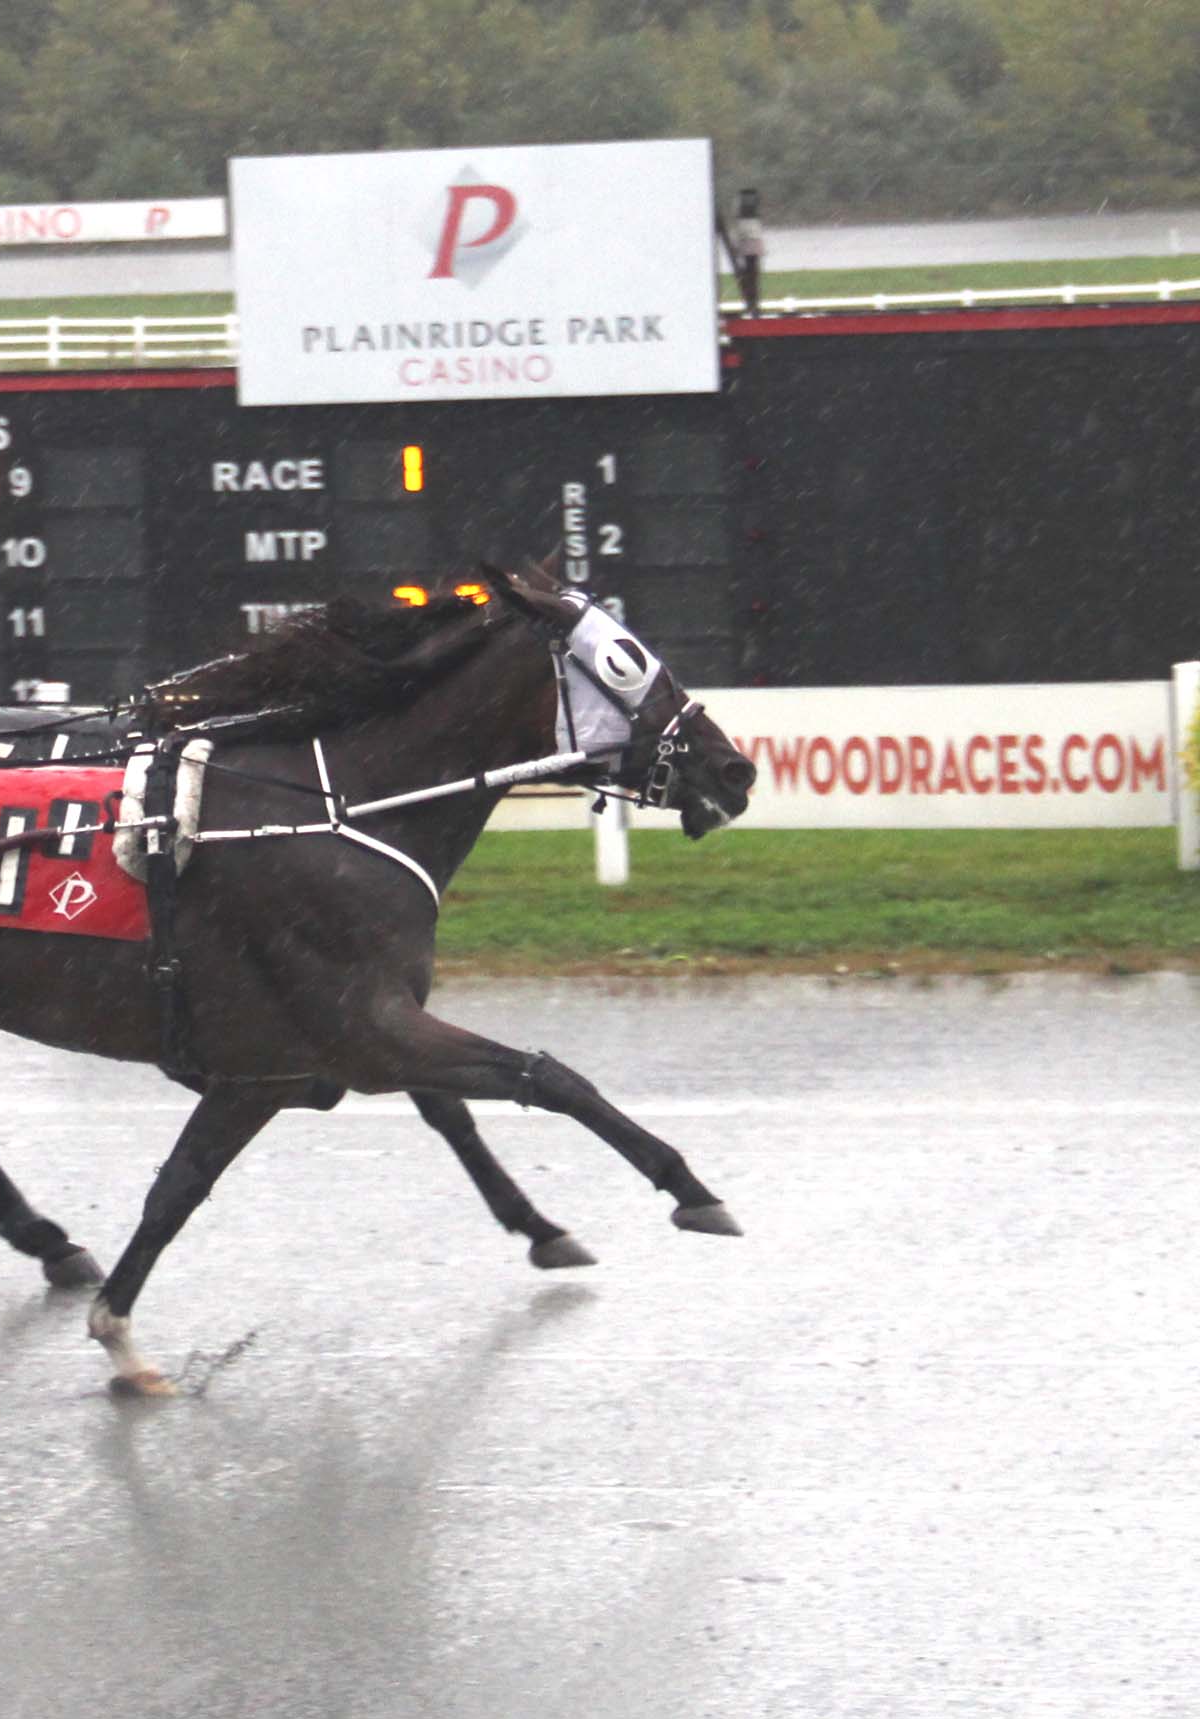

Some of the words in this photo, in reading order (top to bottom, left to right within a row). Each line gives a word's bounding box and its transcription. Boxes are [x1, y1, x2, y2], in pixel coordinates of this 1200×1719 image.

[427, 184, 517, 279] P
[302, 318, 547, 353] PLAINRIDGE
[566, 314, 665, 344] PARK
[399, 354, 552, 387] CASINO
[10, 467, 32, 497] 9
[212, 458, 324, 492] RACE
[402, 445, 423, 492] 1
[596, 454, 616, 484] 1
[1, 537, 47, 569] 10
[245, 531, 327, 563] MTP
[598, 524, 623, 555] 2
[8, 608, 45, 637] 11
[58, 803, 82, 855] 1
